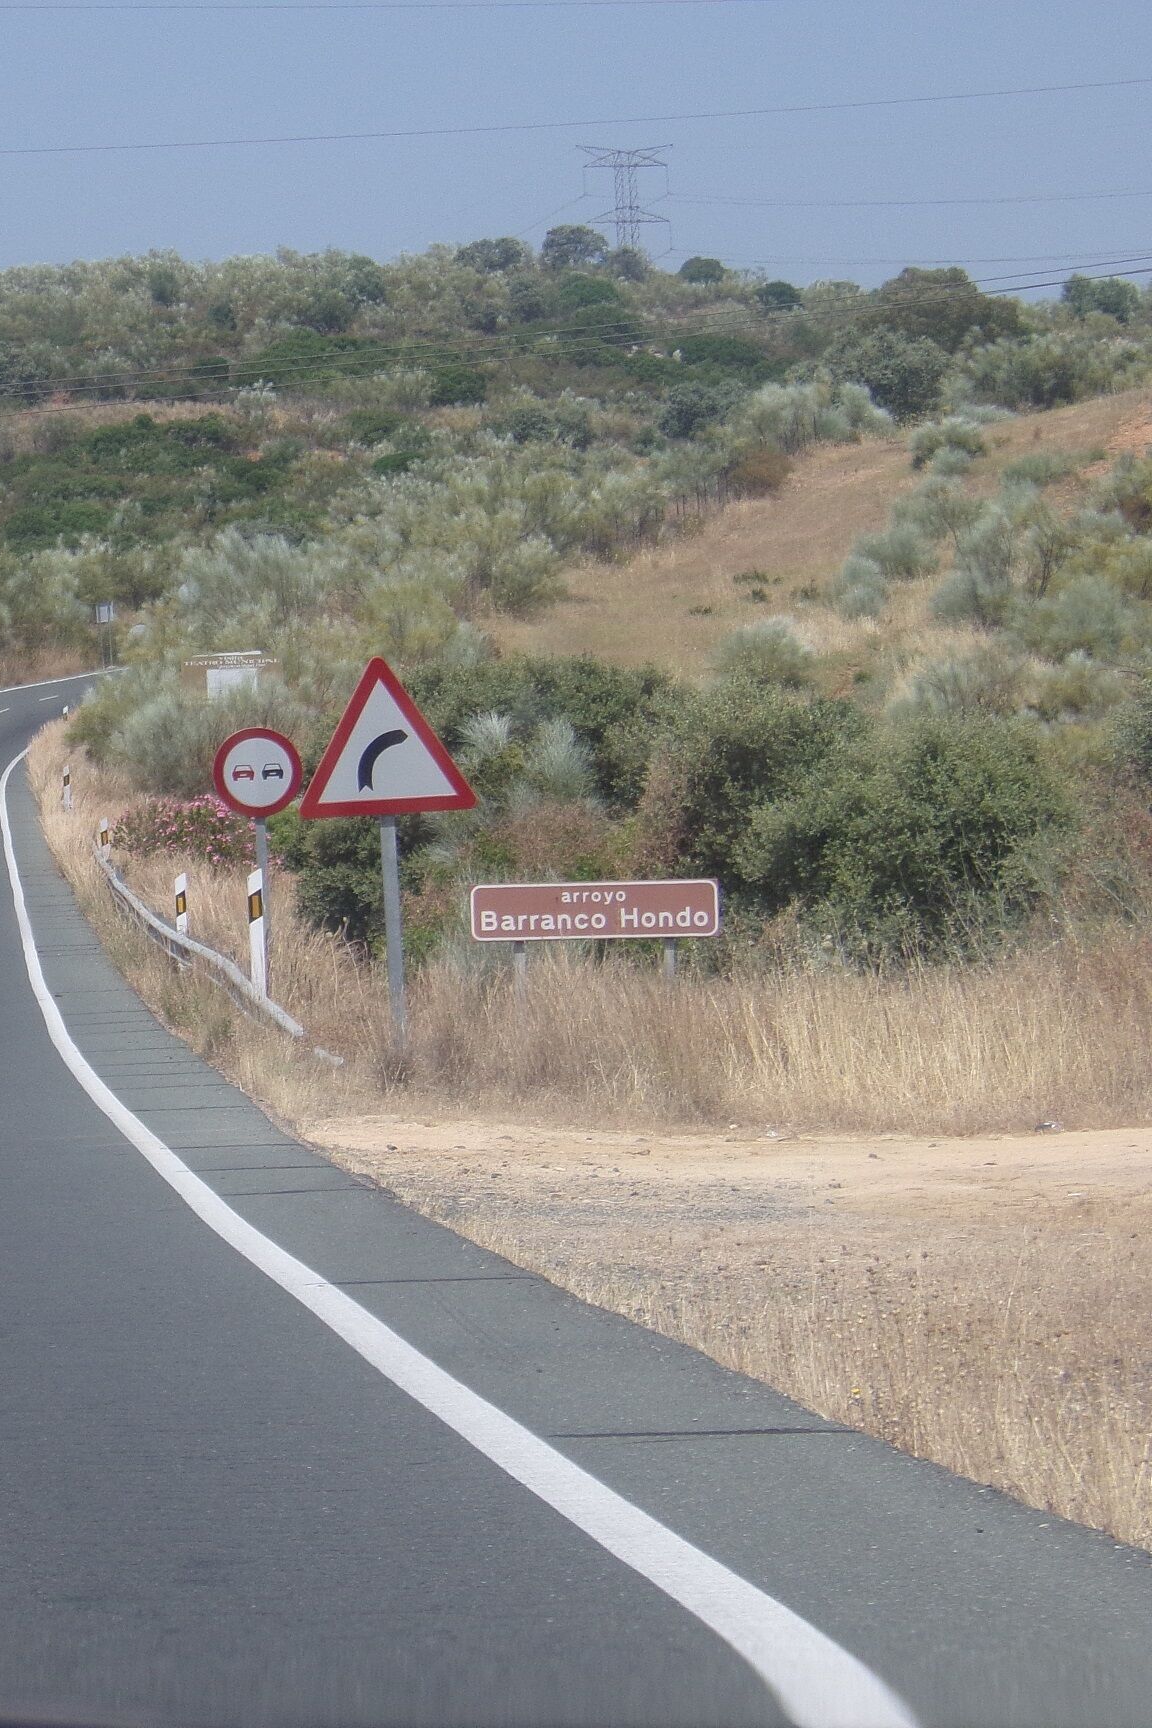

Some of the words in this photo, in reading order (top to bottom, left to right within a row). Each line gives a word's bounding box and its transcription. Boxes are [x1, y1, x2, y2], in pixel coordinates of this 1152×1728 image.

[561, 891, 626, 904] arroyo
[480, 910, 606, 931] Barranco
[620, 907, 709, 928] Hondo
